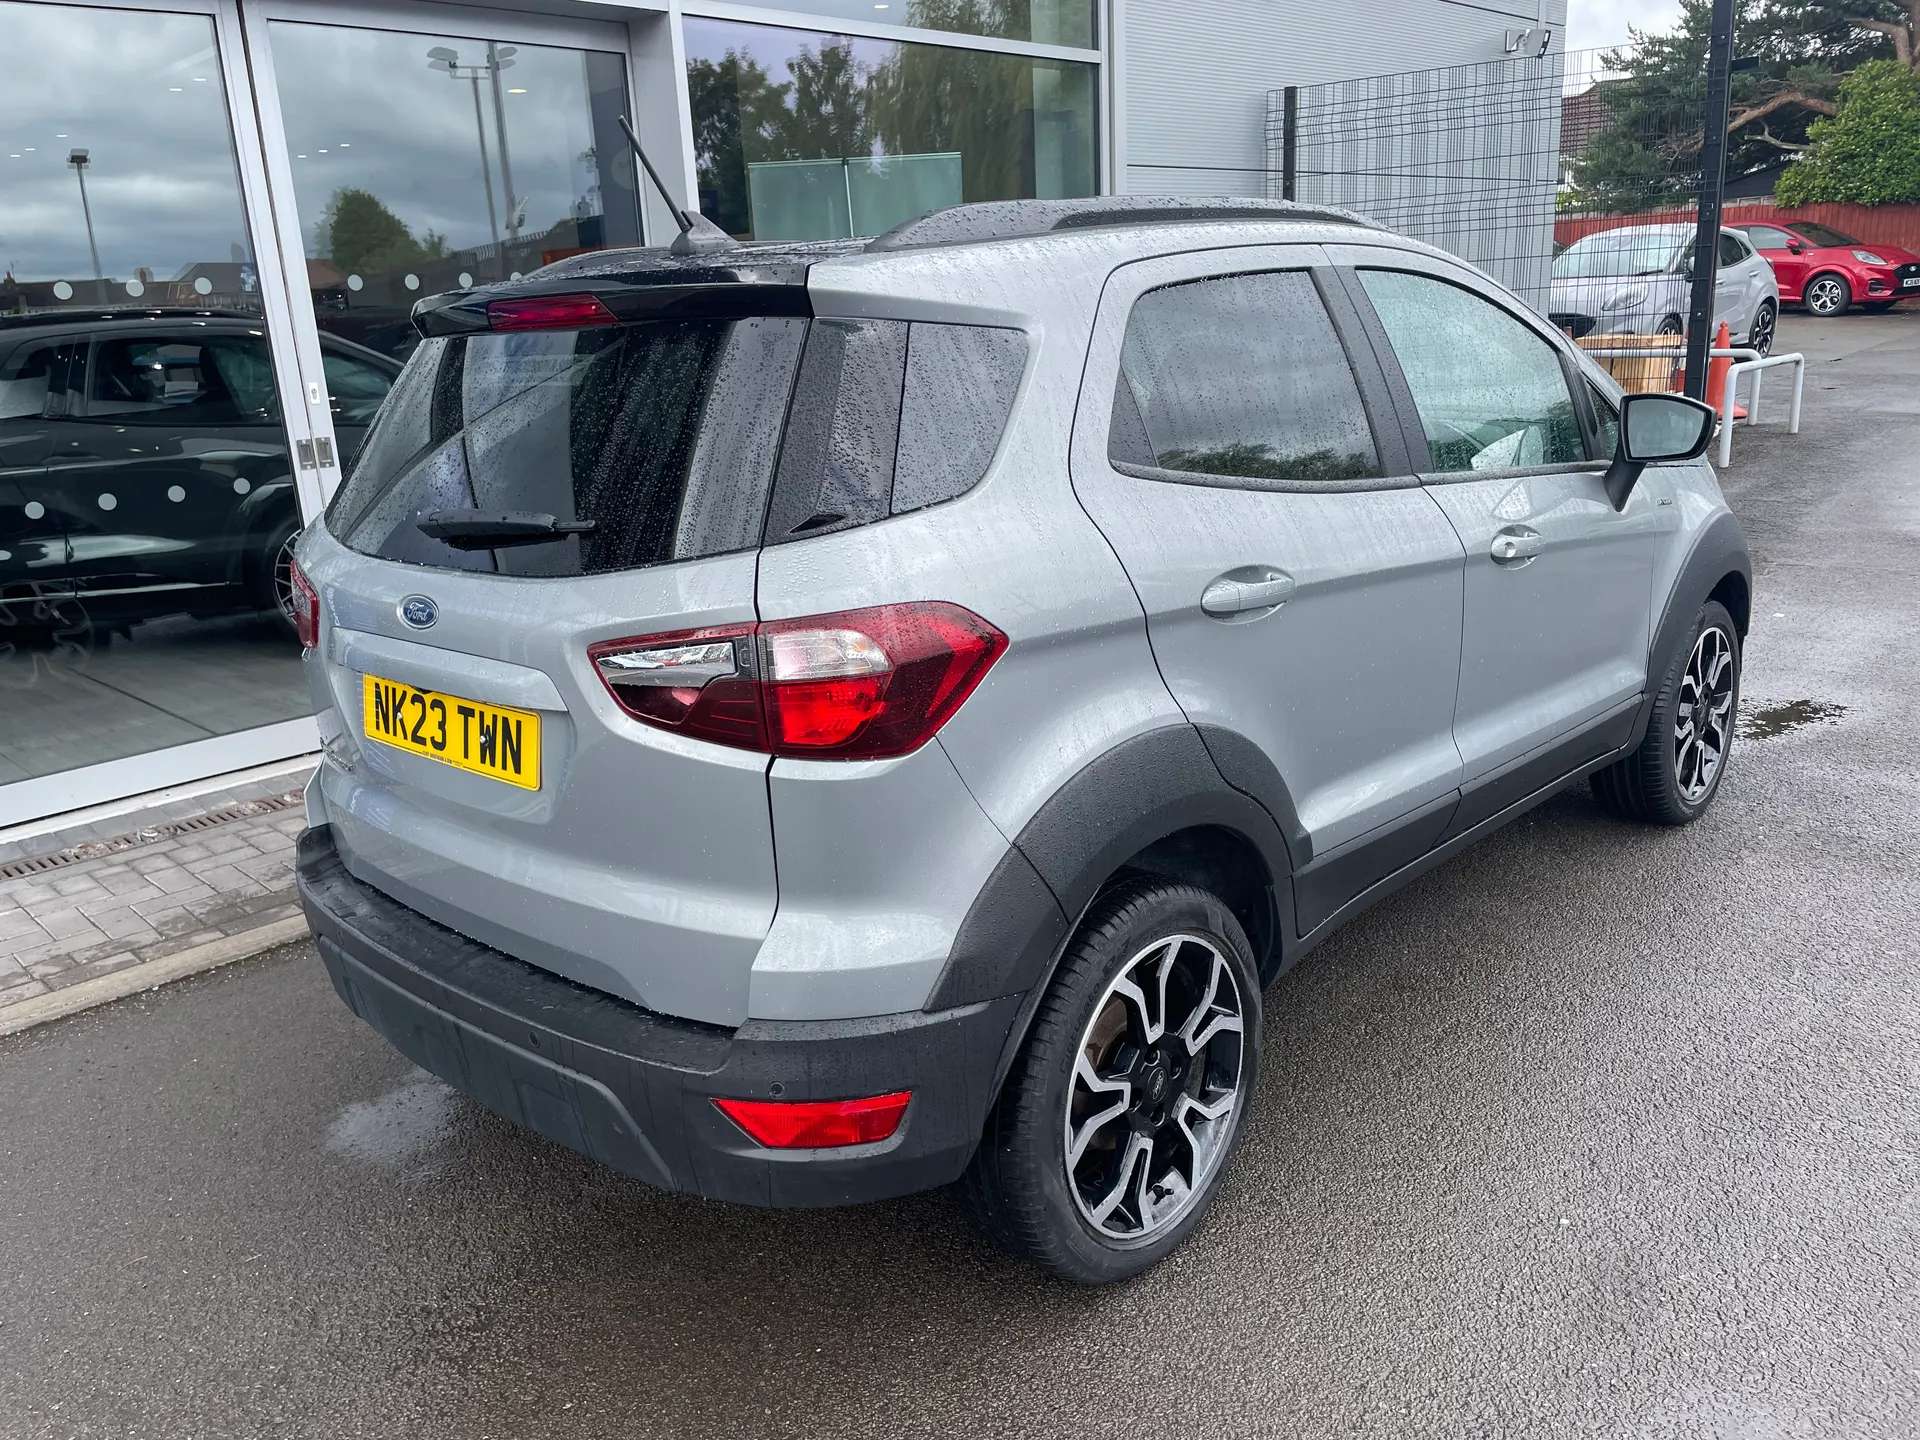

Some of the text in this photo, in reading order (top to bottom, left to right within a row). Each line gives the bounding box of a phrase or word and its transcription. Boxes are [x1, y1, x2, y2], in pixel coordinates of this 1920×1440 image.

[407, 601, 431, 621] Ford
[374, 682, 522, 775] NK23 TWN
